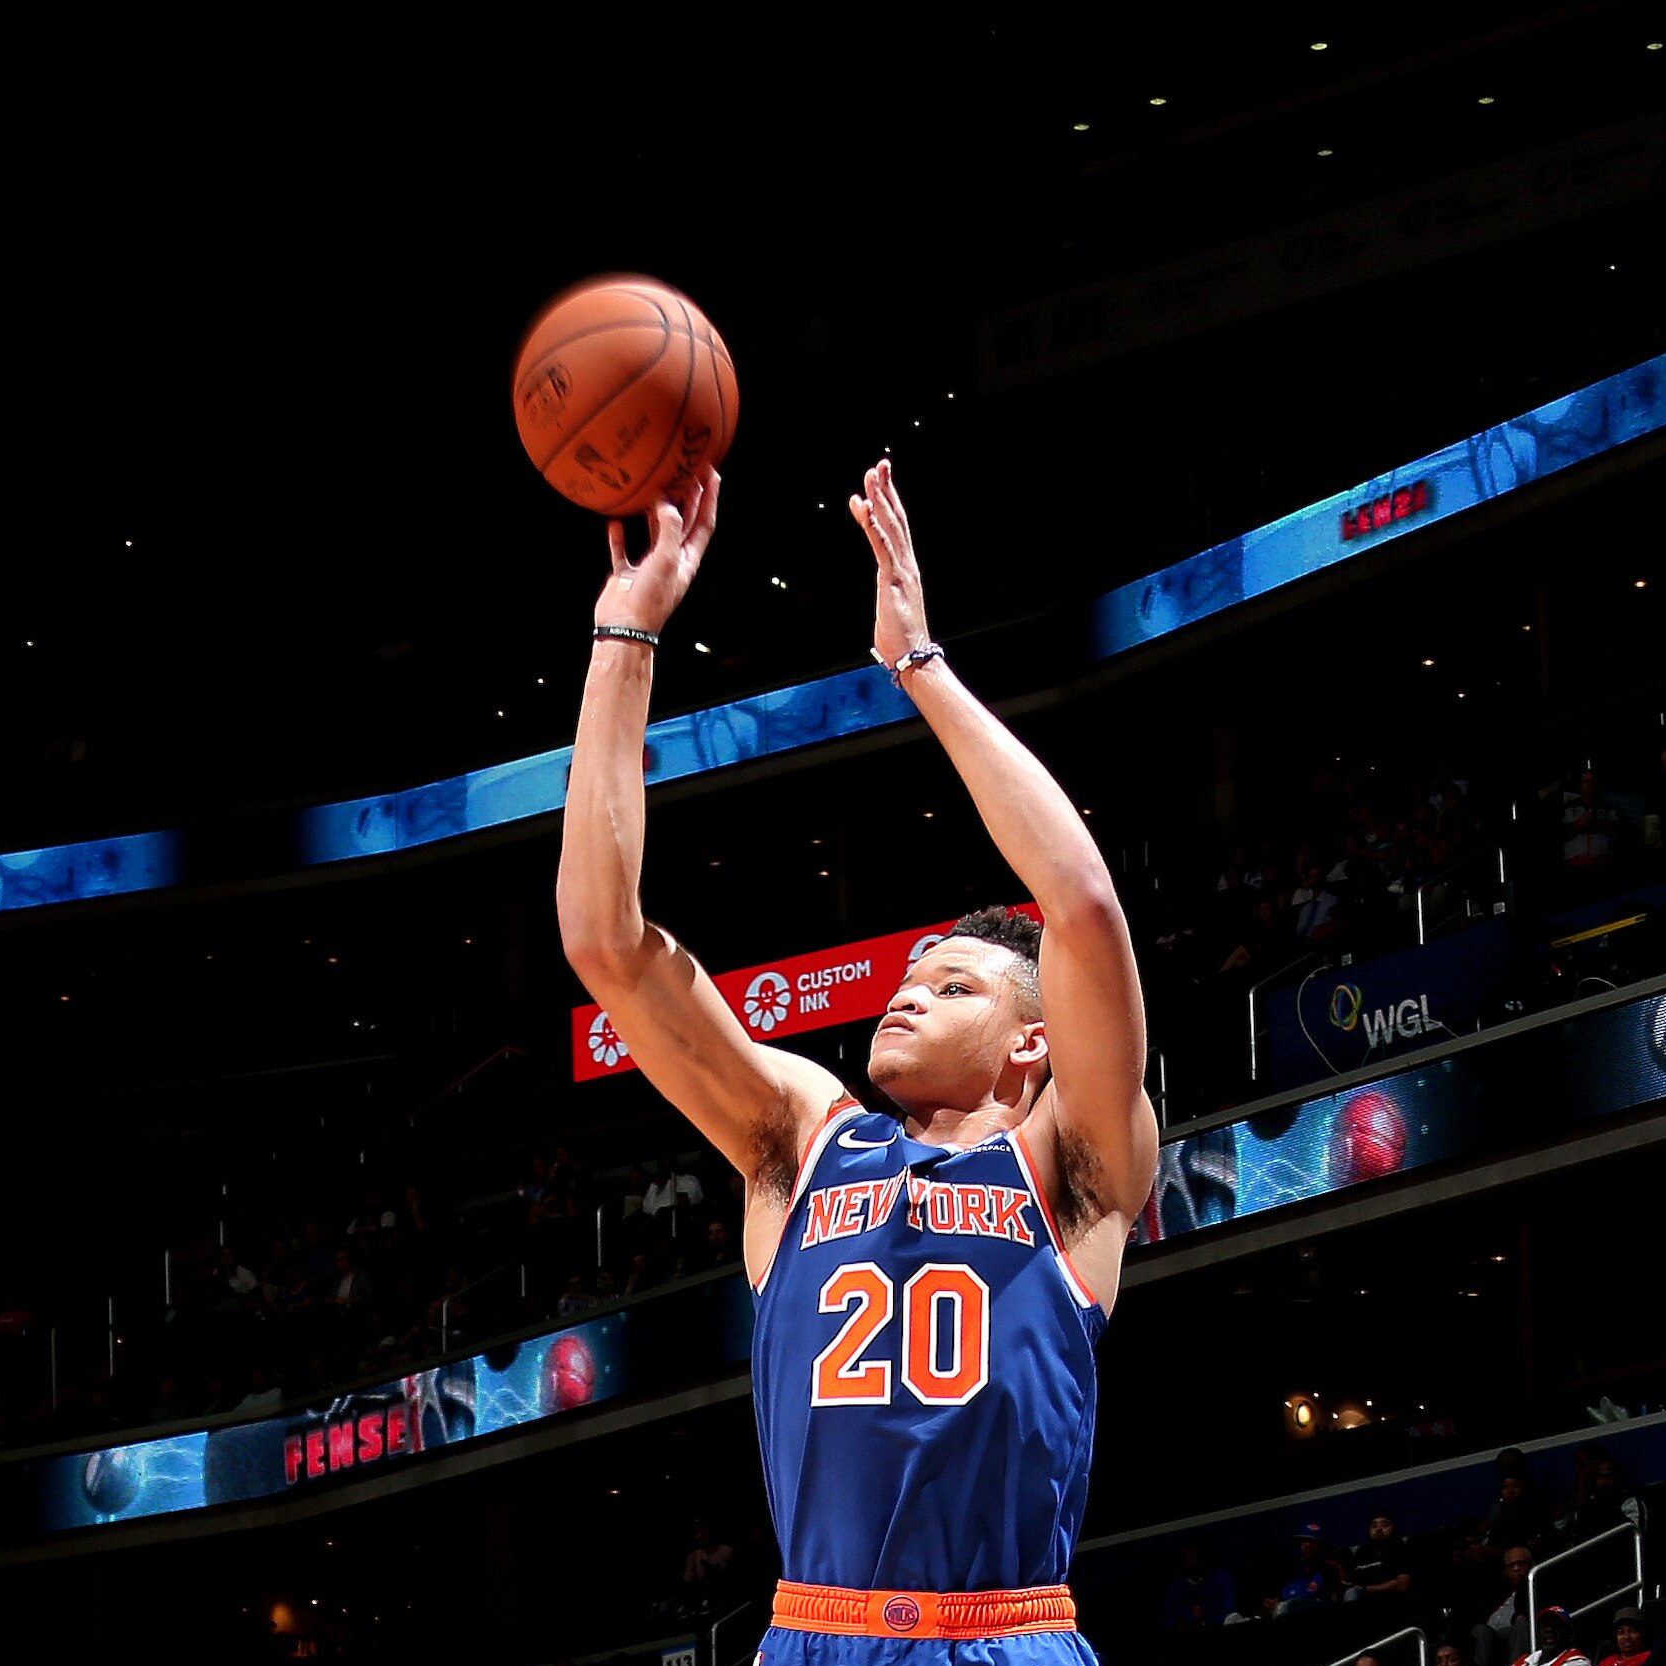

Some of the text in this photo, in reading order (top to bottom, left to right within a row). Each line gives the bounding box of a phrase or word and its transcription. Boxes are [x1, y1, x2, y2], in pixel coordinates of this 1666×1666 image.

[796, 959, 872, 992] CUSTOM
[799, 990, 831, 1013] INK
[1361, 996, 1442, 1047] WGL
[799, 1165, 1036, 1251] NEW YORK
[810, 1260, 990, 1407] 20
[284, 1405, 406, 1486] FENSE
